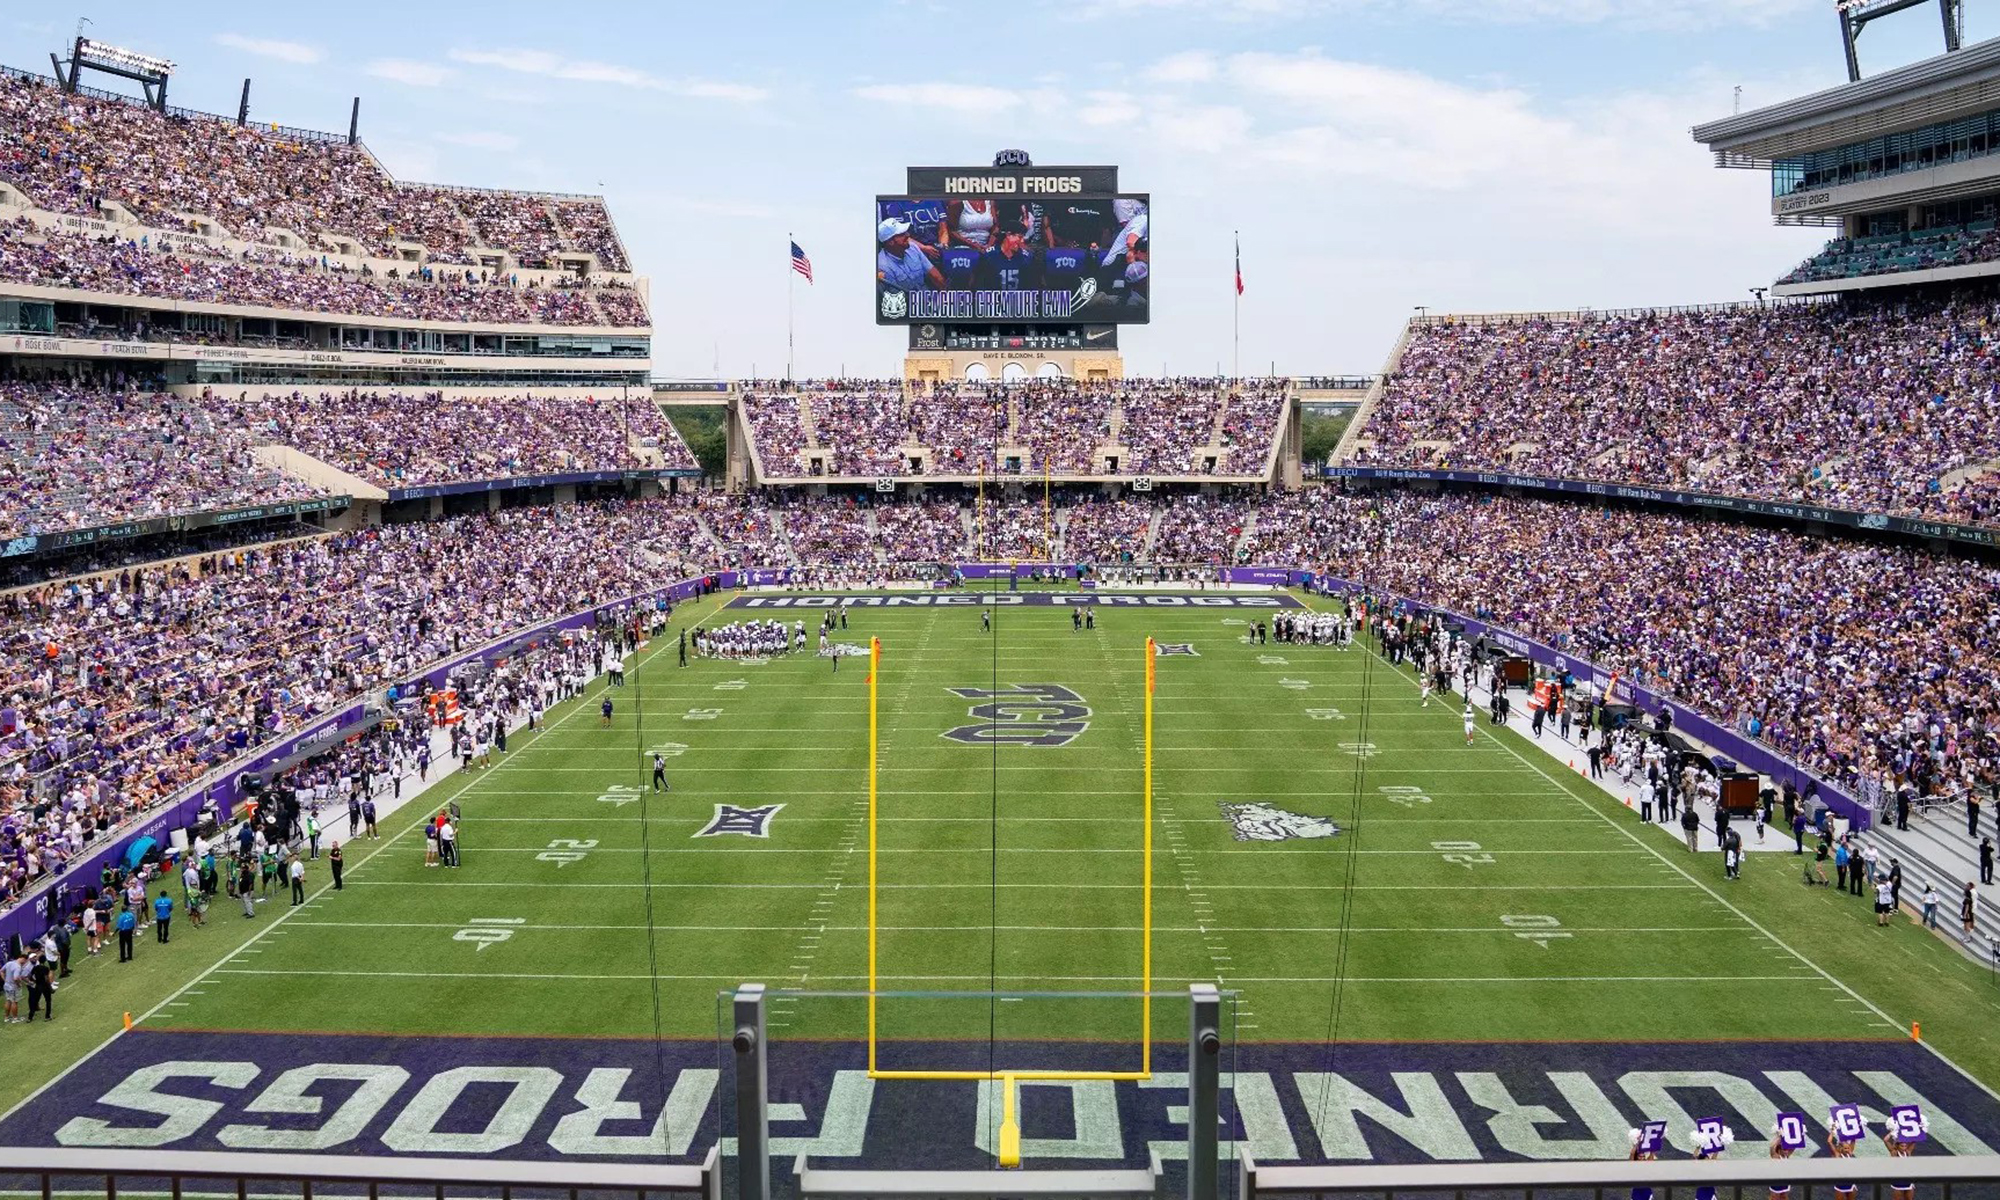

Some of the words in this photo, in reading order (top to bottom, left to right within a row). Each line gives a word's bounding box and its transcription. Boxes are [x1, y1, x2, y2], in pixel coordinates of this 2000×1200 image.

[997, 149, 1028, 165] TCU
[945, 177, 1016, 193] HORNED
[1023, 177, 1082, 193] FROGS
[1809, 193, 1829, 205] 2023
[905, 207, 941, 225] TCU
[951, 258, 970, 268] TCU
[1055, 257, 1076, 269] TCU
[999, 269, 1019, 289] 15
[909, 290, 972, 318] BLEACHER
[975, 290, 1039, 318] CREATURE
[1042, 290, 1072, 317] CAM
[24, 340, 42, 350] ROSE
[44, 341, 62, 351] BOWL
[112, 344, 130, 354] PEACH
[917, 338, 939, 347] Frost
[1337, 468, 1358, 476] EECU
[877, 479, 893, 490] 25
[1135, 479, 1150, 490] 25
[745, 595, 1024, 607] HORNED
[1051, 594, 1282, 607] FROGS
[938, 683, 1093, 746] TCU
[318, 722, 338, 741] FROGS
[535, 838, 599, 862] 20
[1430, 841, 1496, 863] 20
[452, 917, 526, 943] 10
[1499, 914, 1574, 938] 10
[56, 1060, 876, 1158] FROGS
[976, 1070, 1998, 1160] HORNED
[1641, 1124, 1663, 1149] F
[1700, 1120, 1722, 1151] R
[1781, 1117, 1802, 1145] O
[1836, 1108, 1861, 1136] G
[1896, 1109, 1920, 1137] S
